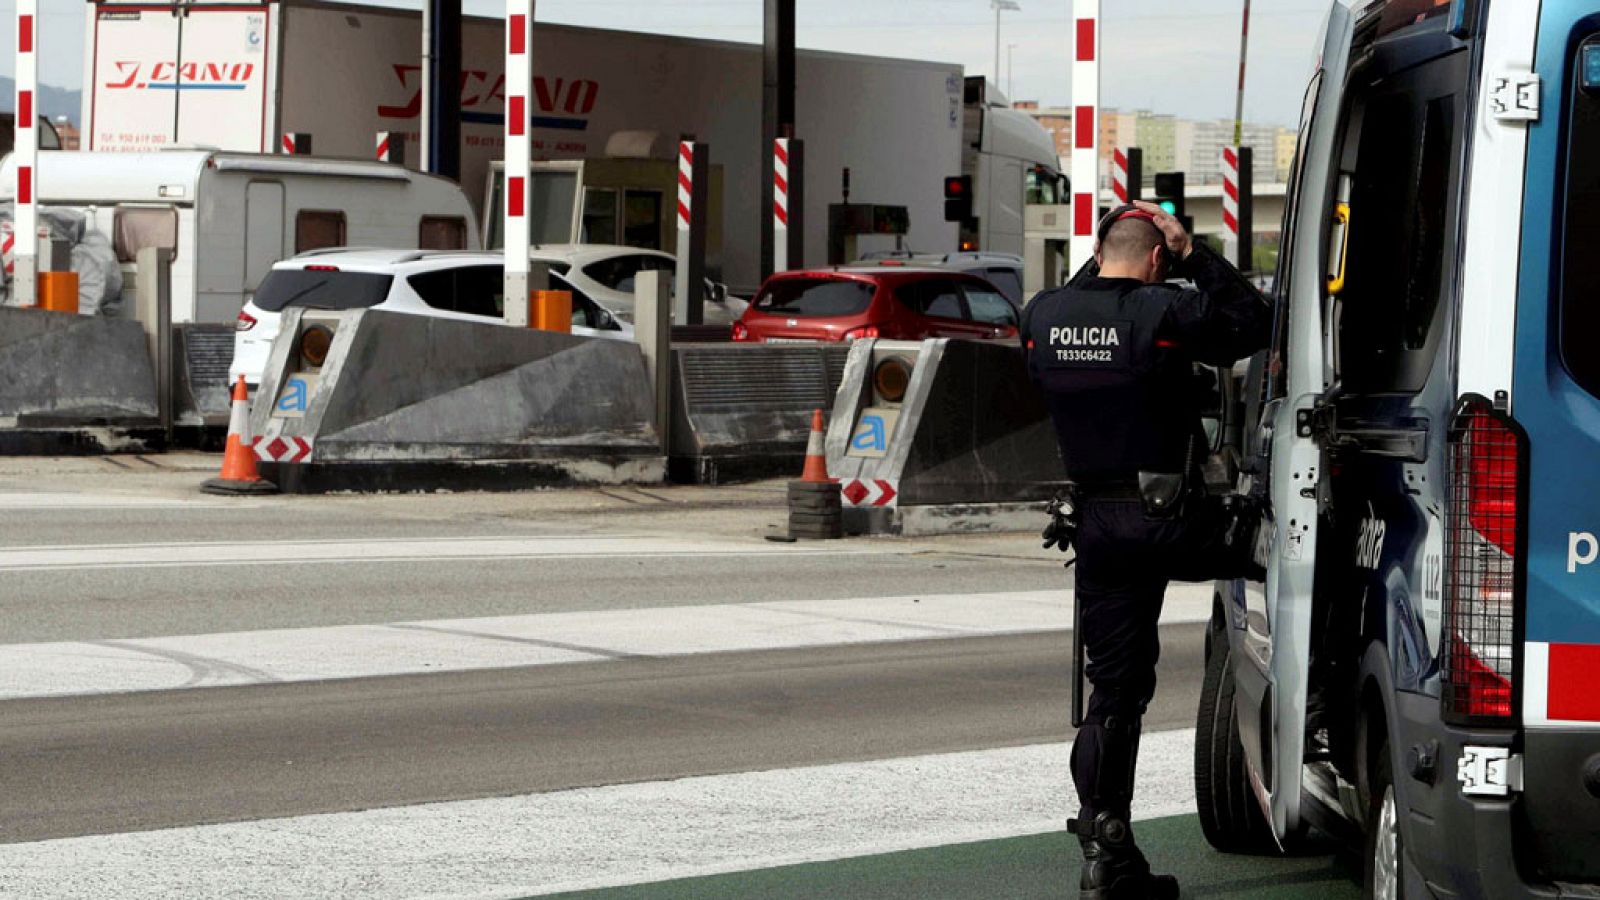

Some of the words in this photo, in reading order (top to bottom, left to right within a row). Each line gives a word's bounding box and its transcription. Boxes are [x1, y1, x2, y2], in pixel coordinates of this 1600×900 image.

[1050, 327, 1120, 346] POLICIA
[1056, 349, 1112, 362] T833C6422
[852, 415, 886, 451] a
[1424, 554, 1440, 601] 112
